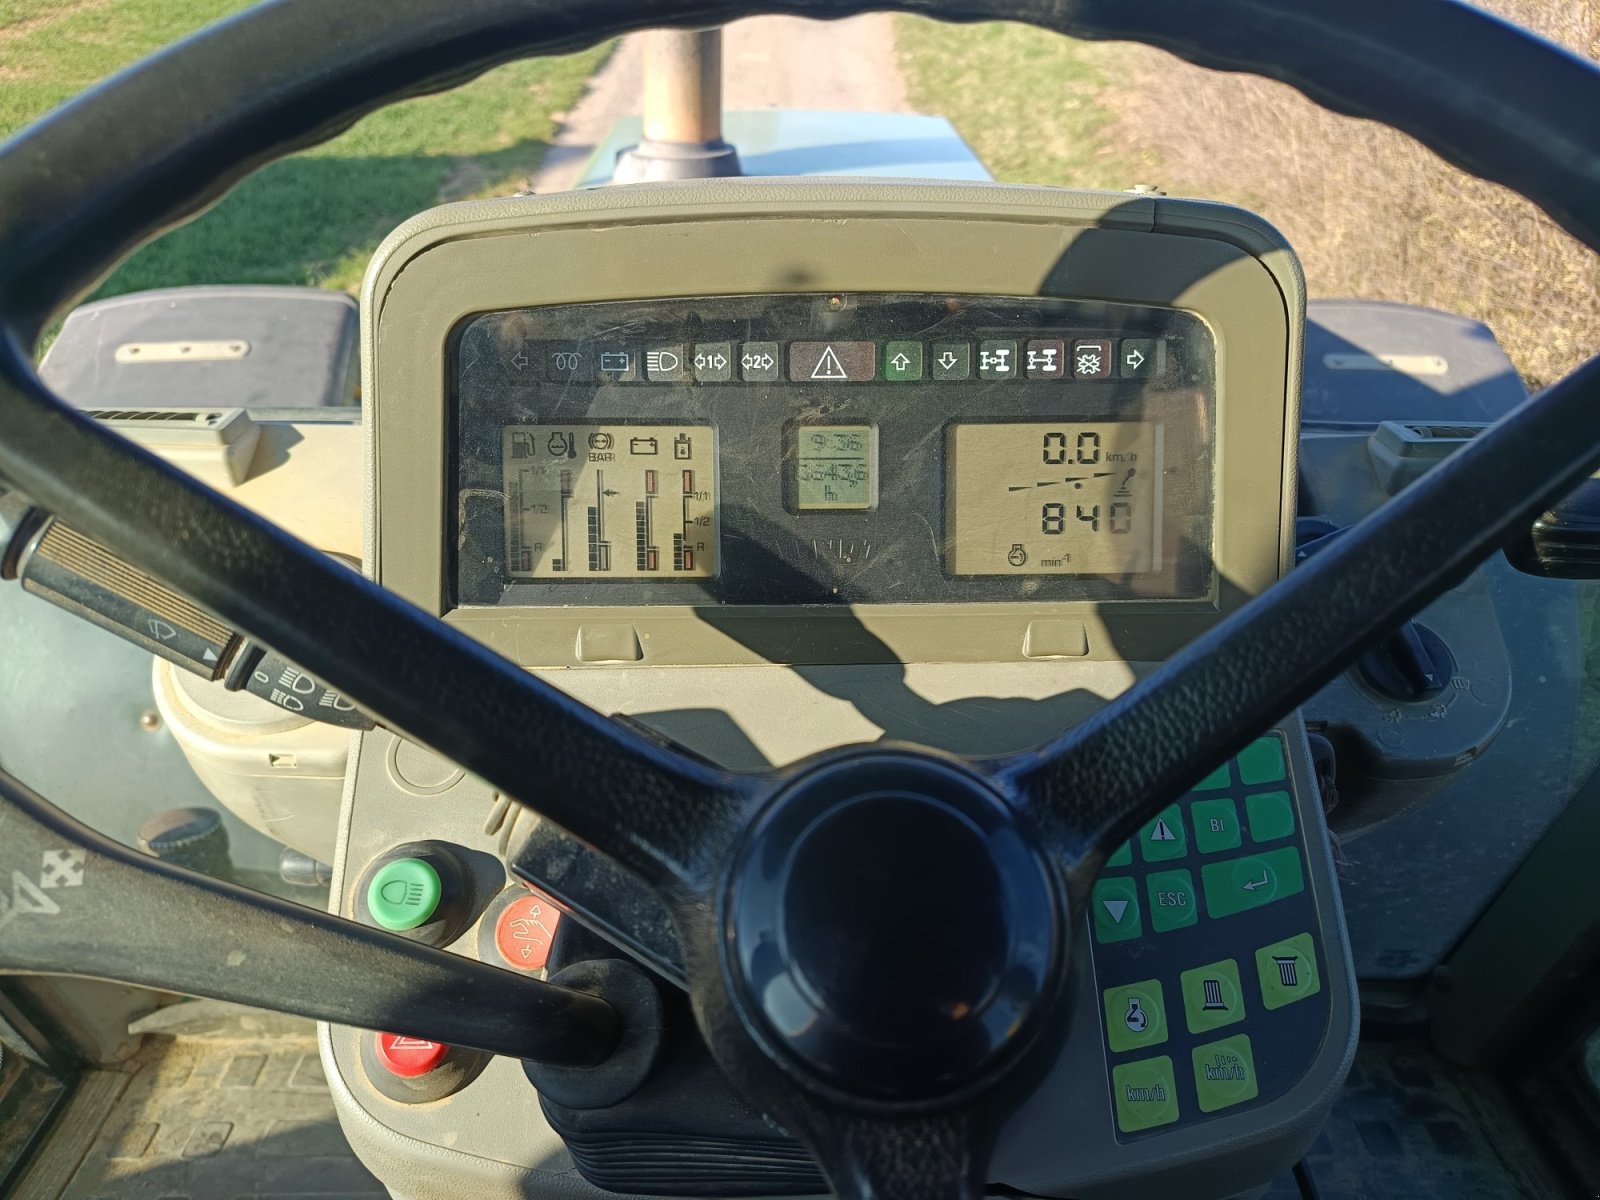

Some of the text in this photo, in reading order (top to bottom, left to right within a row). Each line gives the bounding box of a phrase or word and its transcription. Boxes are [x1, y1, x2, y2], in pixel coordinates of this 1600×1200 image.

[707, 355, 714, 369] 1
[752, 355, 762, 369] 2
[1043, 432, 1138, 465] 0.0 km/h
[588, 452, 616, 463] BAR
[693, 516, 711, 527] 1/2
[1041, 502, 1133, 535] 840
[1158, 891, 1187, 907] ESC
[1205, 1063, 1246, 1081] km/h
[1125, 1083, 1167, 1102] km/h
